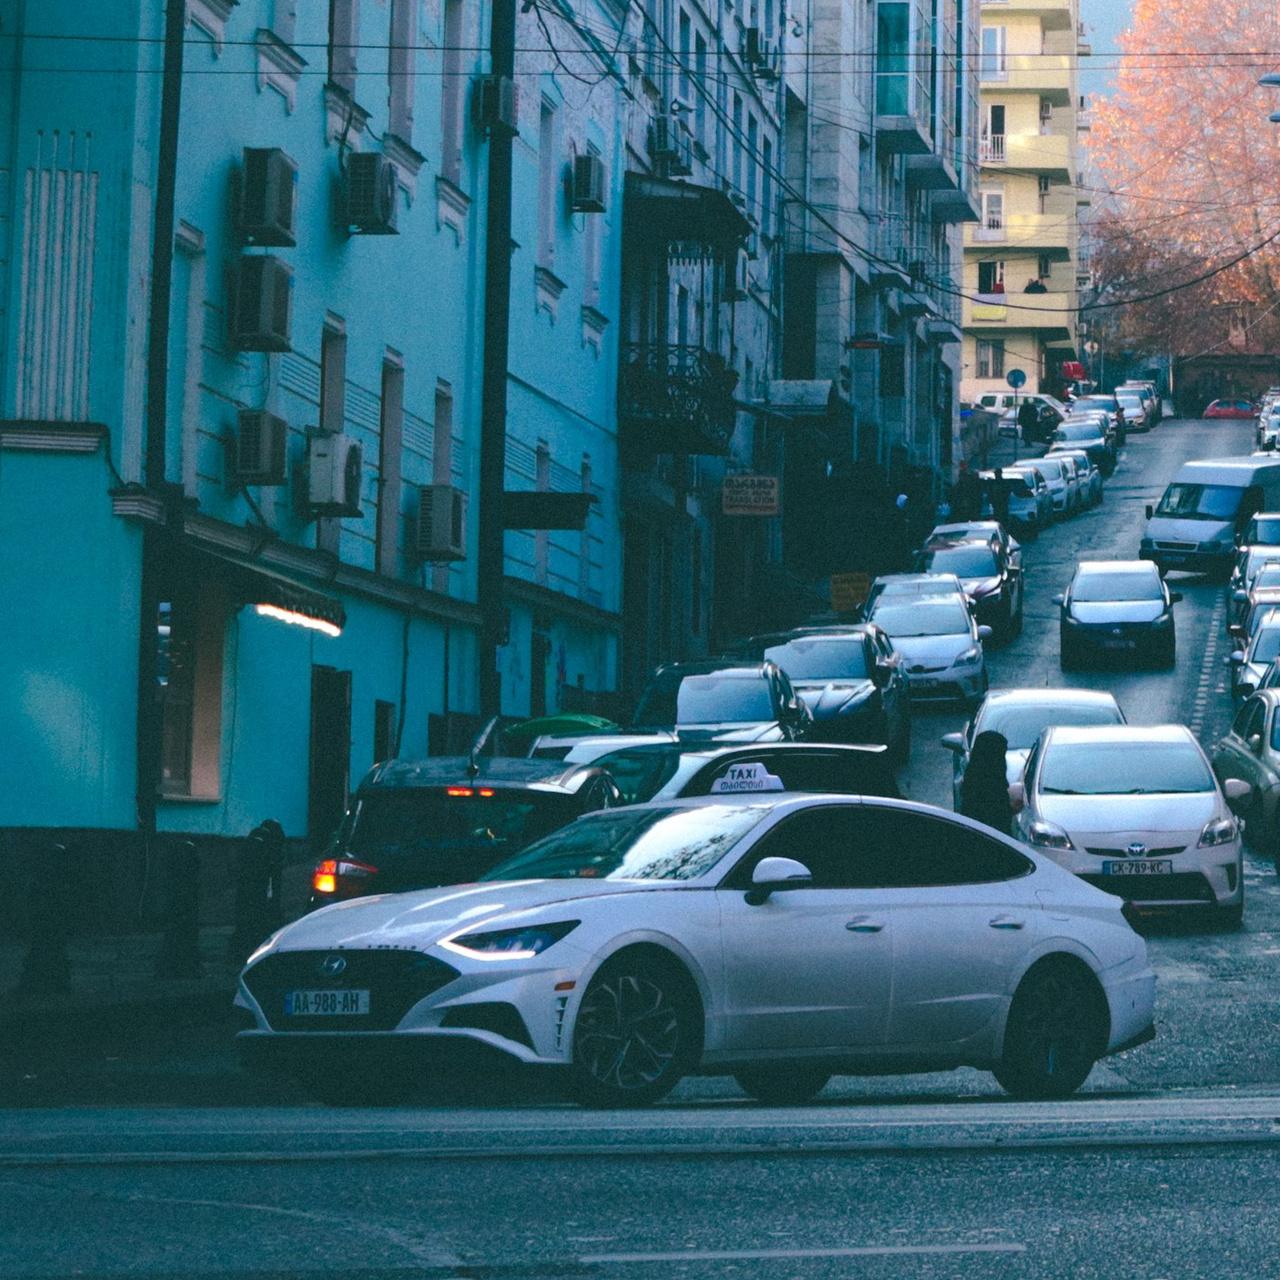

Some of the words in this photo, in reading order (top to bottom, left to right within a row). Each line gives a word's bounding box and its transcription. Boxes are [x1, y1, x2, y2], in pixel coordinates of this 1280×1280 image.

[730, 769, 757, 779] TAXI
[1111, 862, 1164, 873] CK-789-KC
[294, 993, 359, 1012] AA-988-AH
